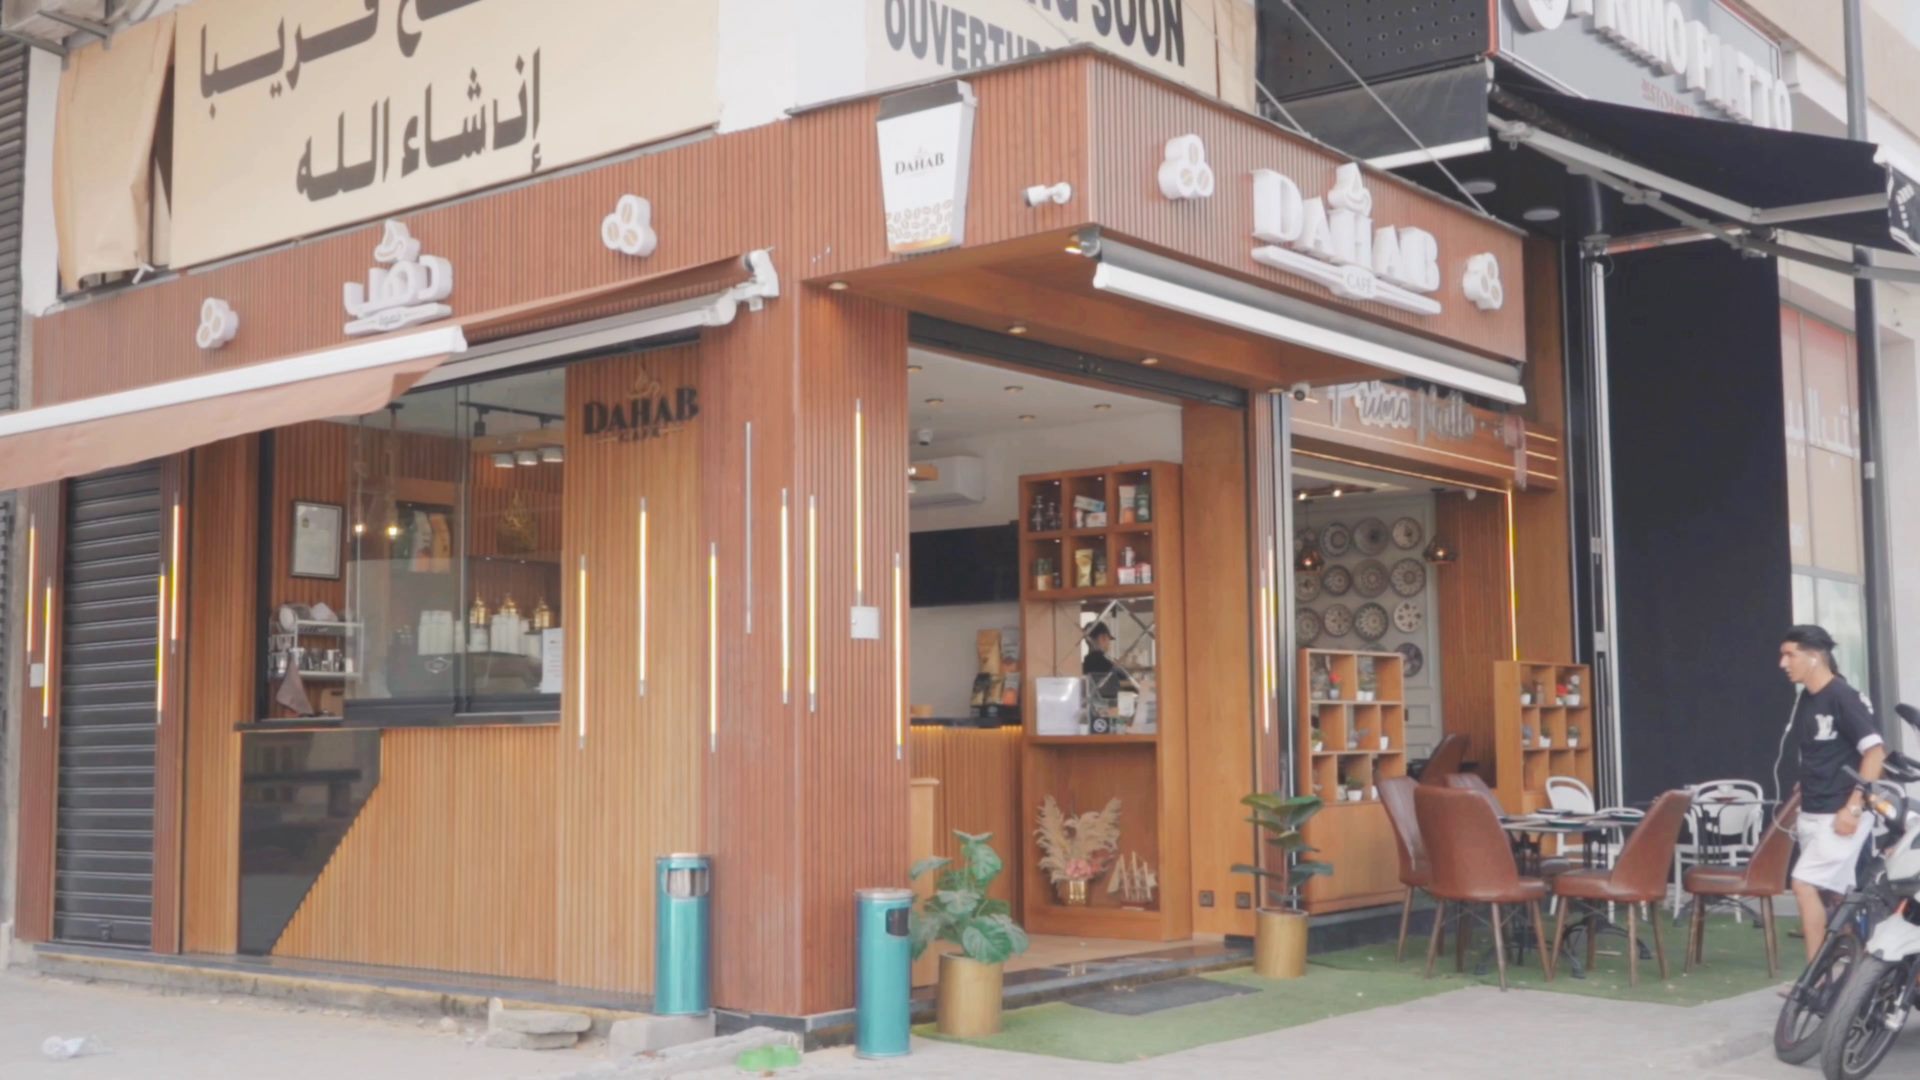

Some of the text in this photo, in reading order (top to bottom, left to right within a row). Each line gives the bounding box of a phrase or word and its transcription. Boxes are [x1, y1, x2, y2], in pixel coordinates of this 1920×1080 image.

[885, 0, 1057, 71] OUVERTU
[1092, 0, 1186, 67] SOON
[296, 96, 389, 202] الله
[894, 152, 944, 176] DAHAB
[1251, 168, 1440, 294] DAHAB
[583, 386, 702, 435] DAHAB
